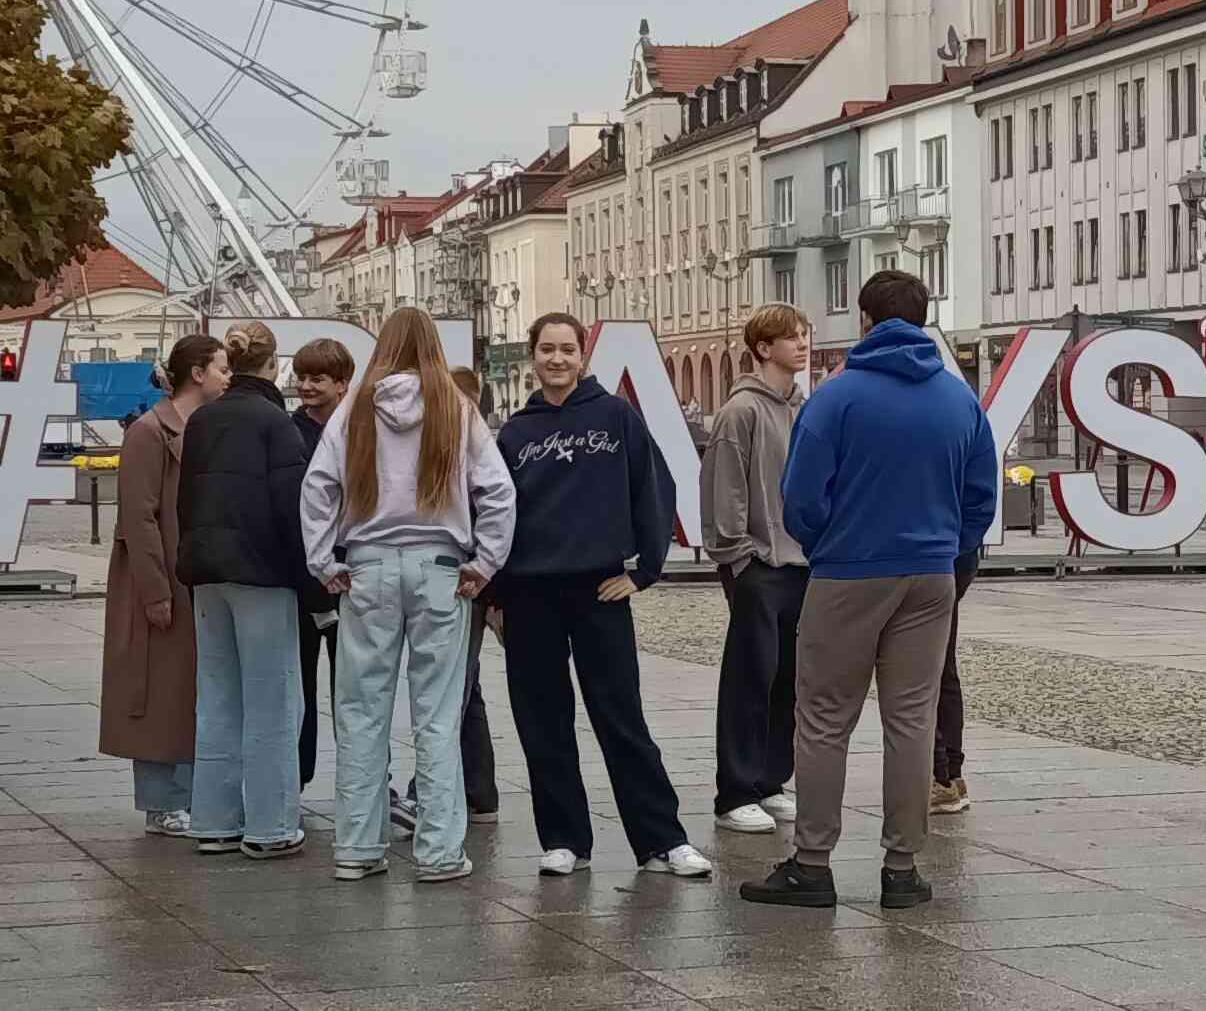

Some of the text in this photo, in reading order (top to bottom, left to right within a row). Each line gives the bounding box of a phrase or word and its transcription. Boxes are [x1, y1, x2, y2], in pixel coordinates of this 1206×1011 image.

[533, 430, 576, 461] Just
[575, 435, 586, 447] a
[585, 429, 621, 454] Girl
